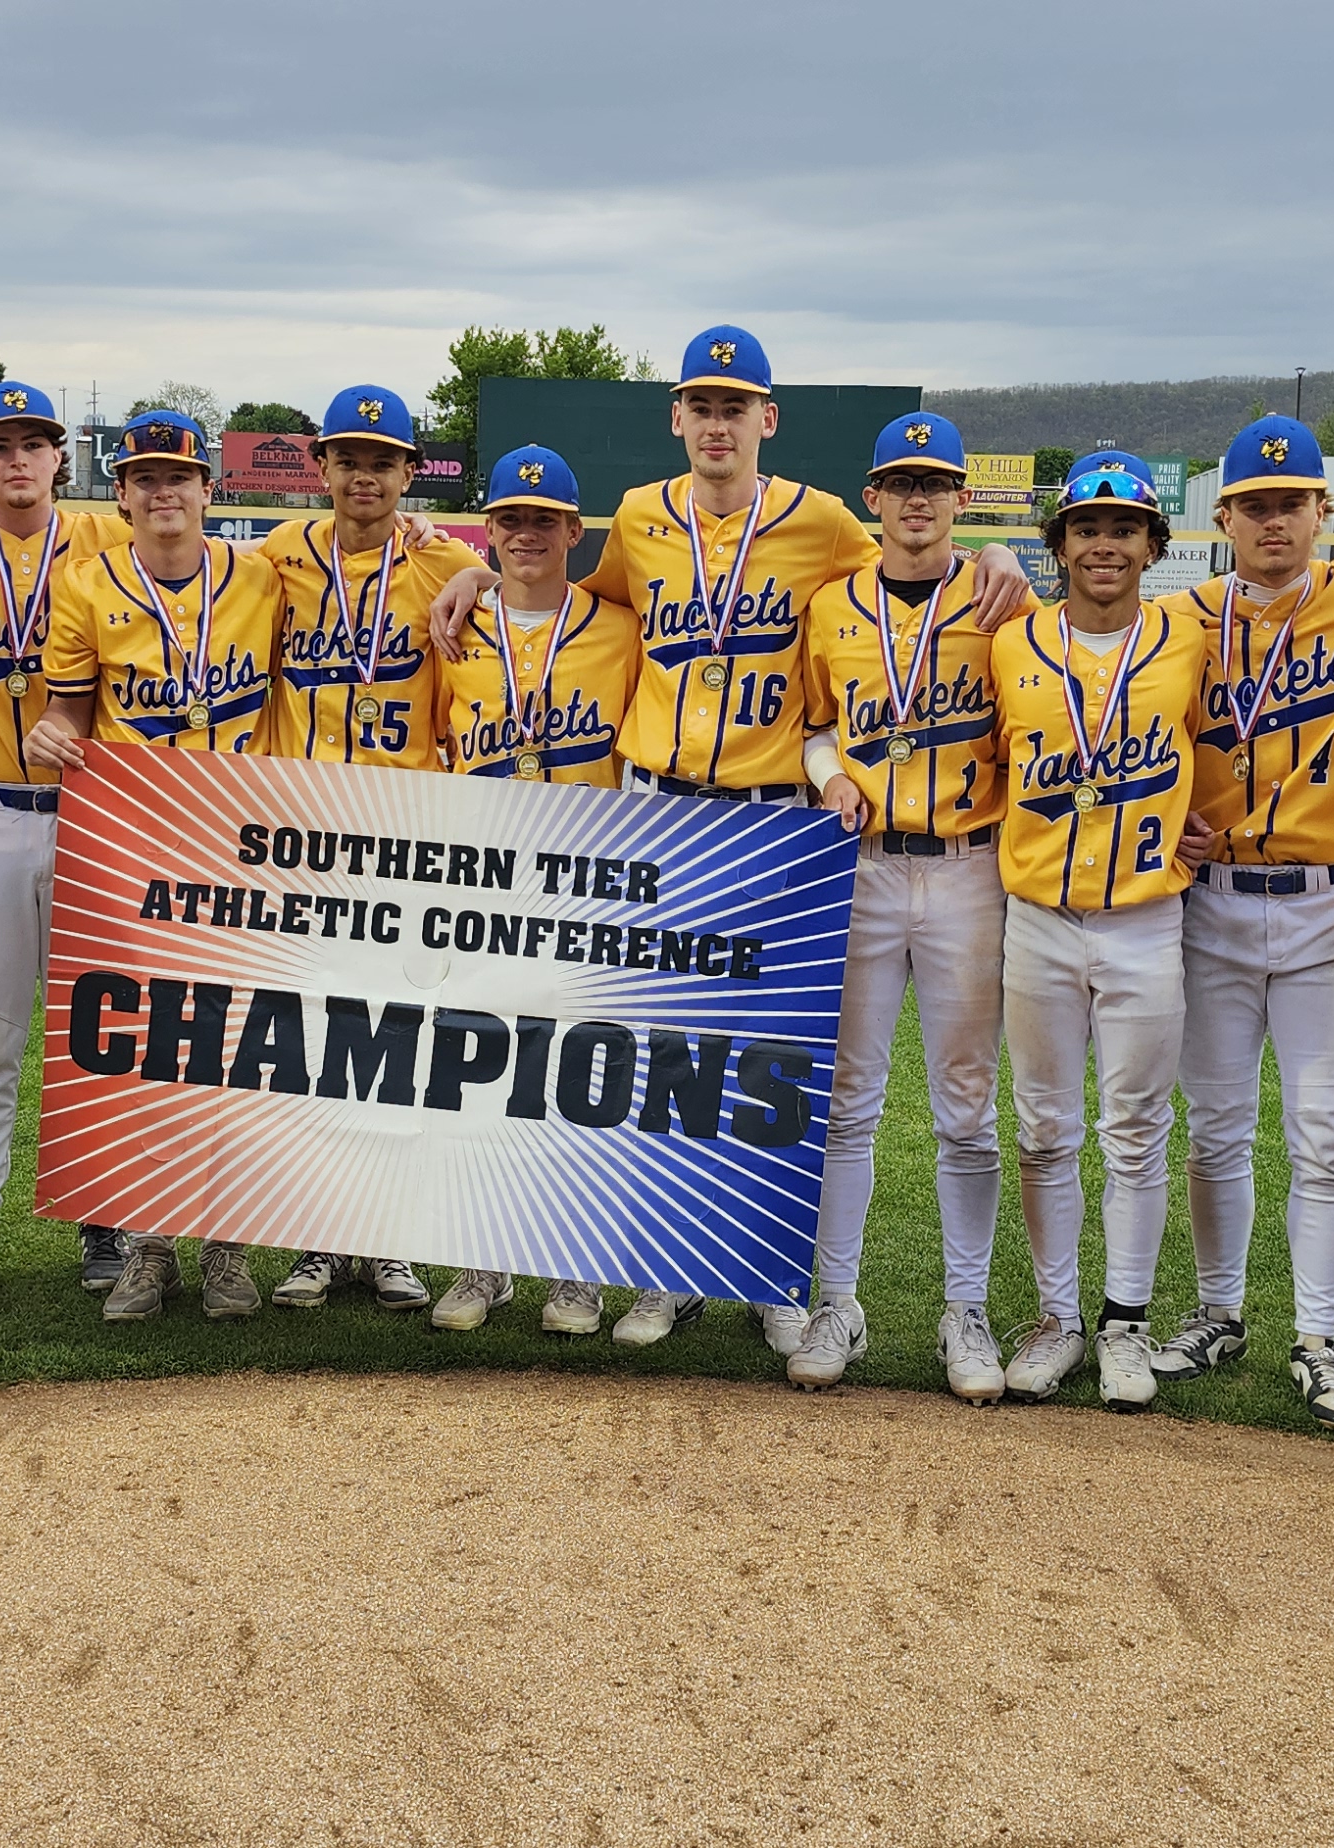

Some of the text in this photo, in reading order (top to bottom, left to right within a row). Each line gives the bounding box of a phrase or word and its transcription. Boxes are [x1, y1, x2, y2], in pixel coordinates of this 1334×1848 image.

[252, 451, 305, 462] BELKNAP
[966, 459, 1028, 473] LY HILL
[1158, 464, 1180, 473] PRIDE
[226, 482, 329, 493] KITCHEN DESIGN STUDIO
[285, 471, 319, 479] MARVIN
[976, 473, 1028, 482] VINEYARDS
[1152, 475, 1179, 485] UALITY
[1156, 486, 1179, 496] METAL
[975, 492, 1027, 502] LAUGHTER!
[1166, 502, 1180, 512] INC
[1163, 550, 1208, 561] AKER
[642, 573, 797, 641] Jackets
[112, 643, 267, 711] Jackets
[734, 671, 787, 727] 16
[359, 700, 412, 753] 15
[461, 688, 607, 762] Jackets
[1307, 730, 1334, 785] 4
[953, 760, 978, 811] 1
[1134, 814, 1165, 874] 2
[237, 822, 661, 905] SOUTHERN TIER
[139, 878, 764, 982] ATHLETIC CONFERENCE
[67, 970, 815, 1149] CHAMPIONS
